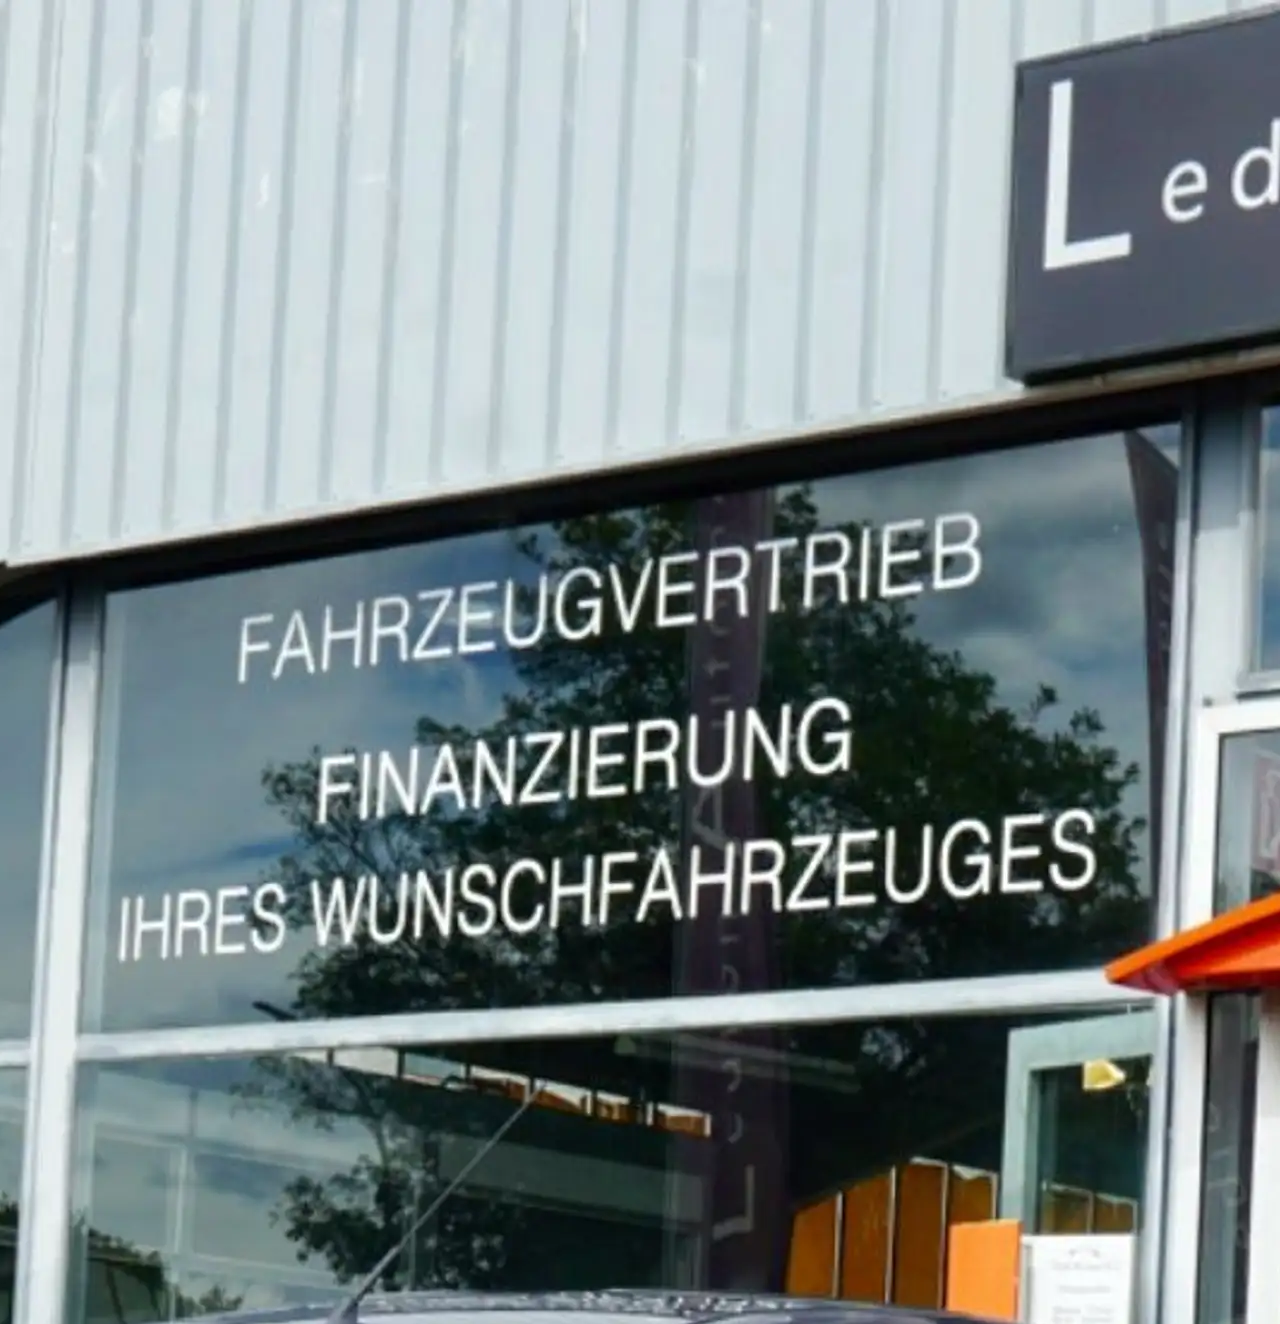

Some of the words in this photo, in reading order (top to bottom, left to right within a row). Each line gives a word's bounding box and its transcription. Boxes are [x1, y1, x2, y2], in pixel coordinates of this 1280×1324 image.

[237, 511, 984, 684] FAHRZEUGVERTRIEB
[316, 695, 854, 825] FINANZIERUNG
[117, 882, 287, 963] IHRES
[312, 809, 1098, 948] WUNSCHFAHRZEUGES
